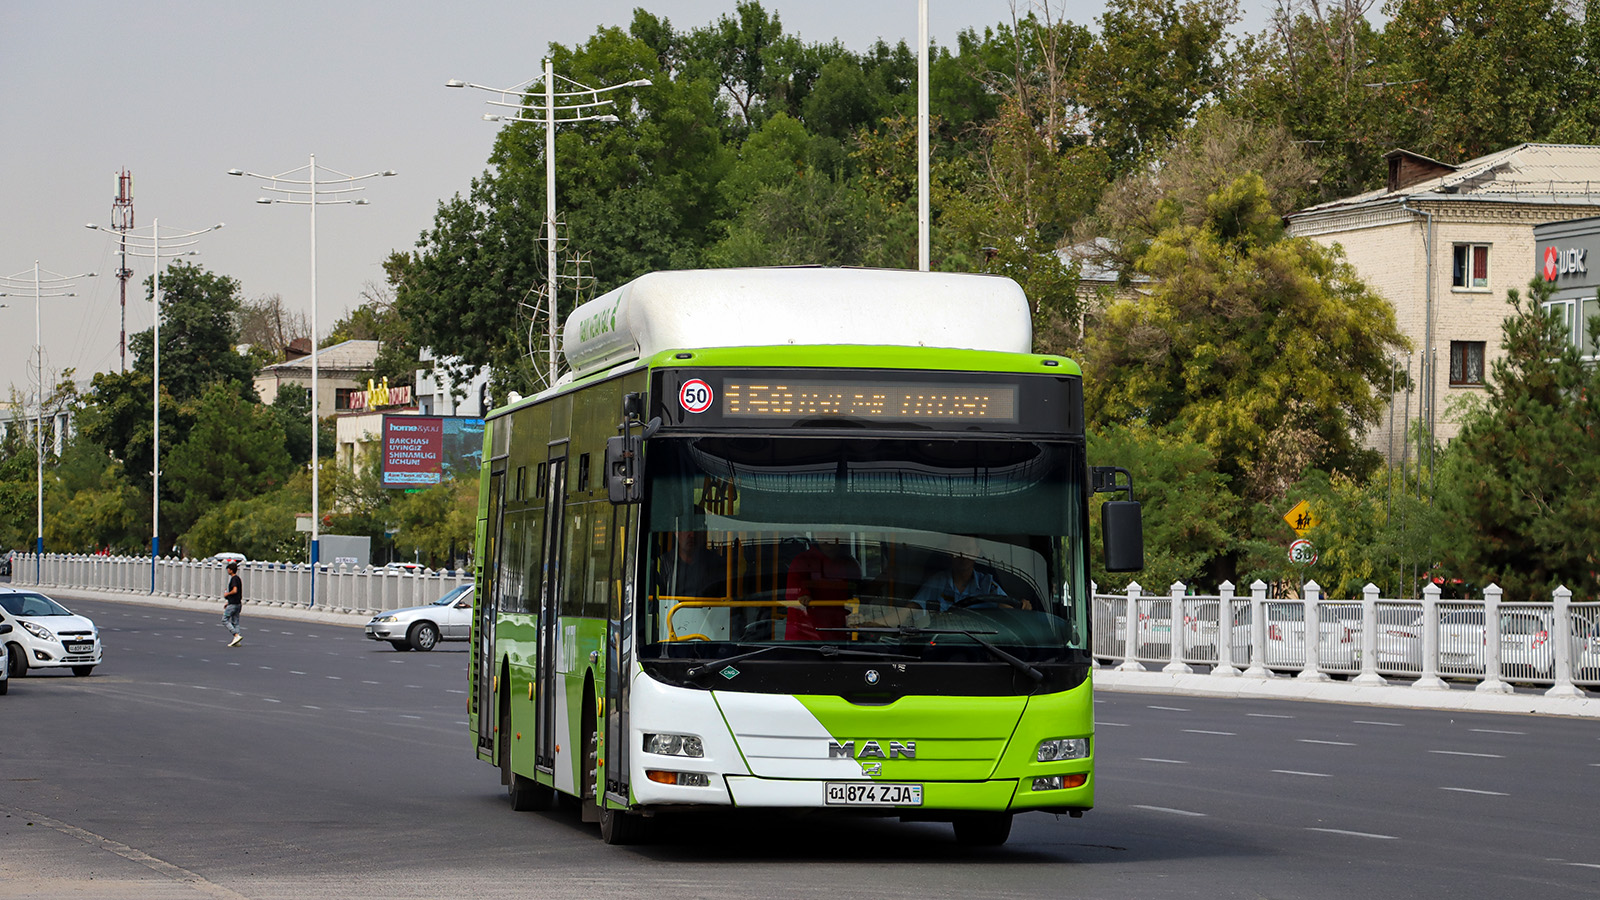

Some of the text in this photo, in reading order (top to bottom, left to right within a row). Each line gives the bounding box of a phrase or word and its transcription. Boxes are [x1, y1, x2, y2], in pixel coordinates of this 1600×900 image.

[685, 388, 707, 403] 50
[829, 741, 916, 758] MAN
[830, 787, 845, 800] 01
[847, 786, 876, 801] 874
[880, 786, 912, 802] ZJA
